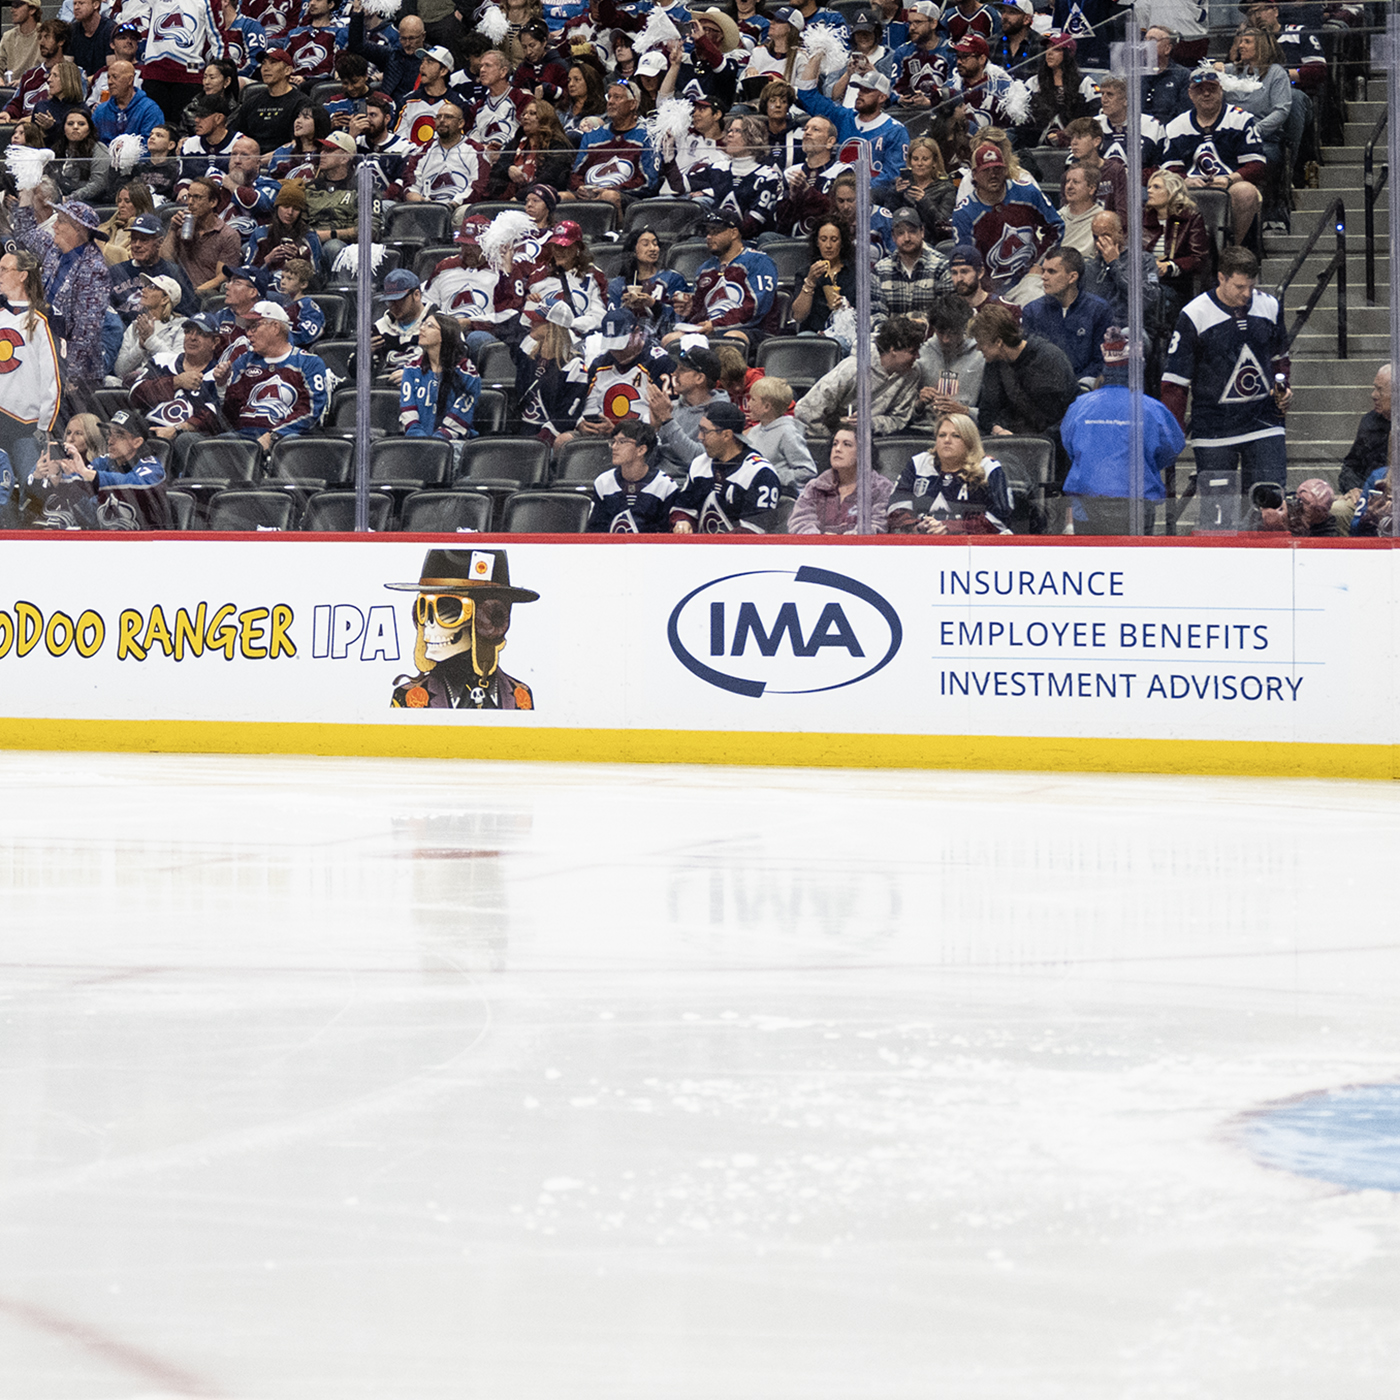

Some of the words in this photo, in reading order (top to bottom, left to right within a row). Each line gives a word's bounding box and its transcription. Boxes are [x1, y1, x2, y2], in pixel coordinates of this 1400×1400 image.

[248, 31, 264, 48] 29
[342, 193, 351, 205] A
[373, 199, 380, 214] 8
[136, 216, 144, 224] C
[514, 280, 523, 295] 8
[757, 275, 773, 291] 13
[301, 320, 318, 335] 29
[314, 373, 322, 390] 8
[401, 382, 410, 401] 9
[758, 486, 778, 508] 29
[957, 484, 967, 500] A
[939, 570, 1125, 597] INSURANCE
[117, 601, 297, 661] RANGER
[311, 604, 400, 661] IPA
[709, 601, 866, 658] IMA
[940, 621, 1108, 648] EMPLOYEE
[1119, 623, 1269, 650] BENEFITS
[940, 670, 1138, 698] INVESTMENT
[1147, 673, 1304, 702] ADVISORY
